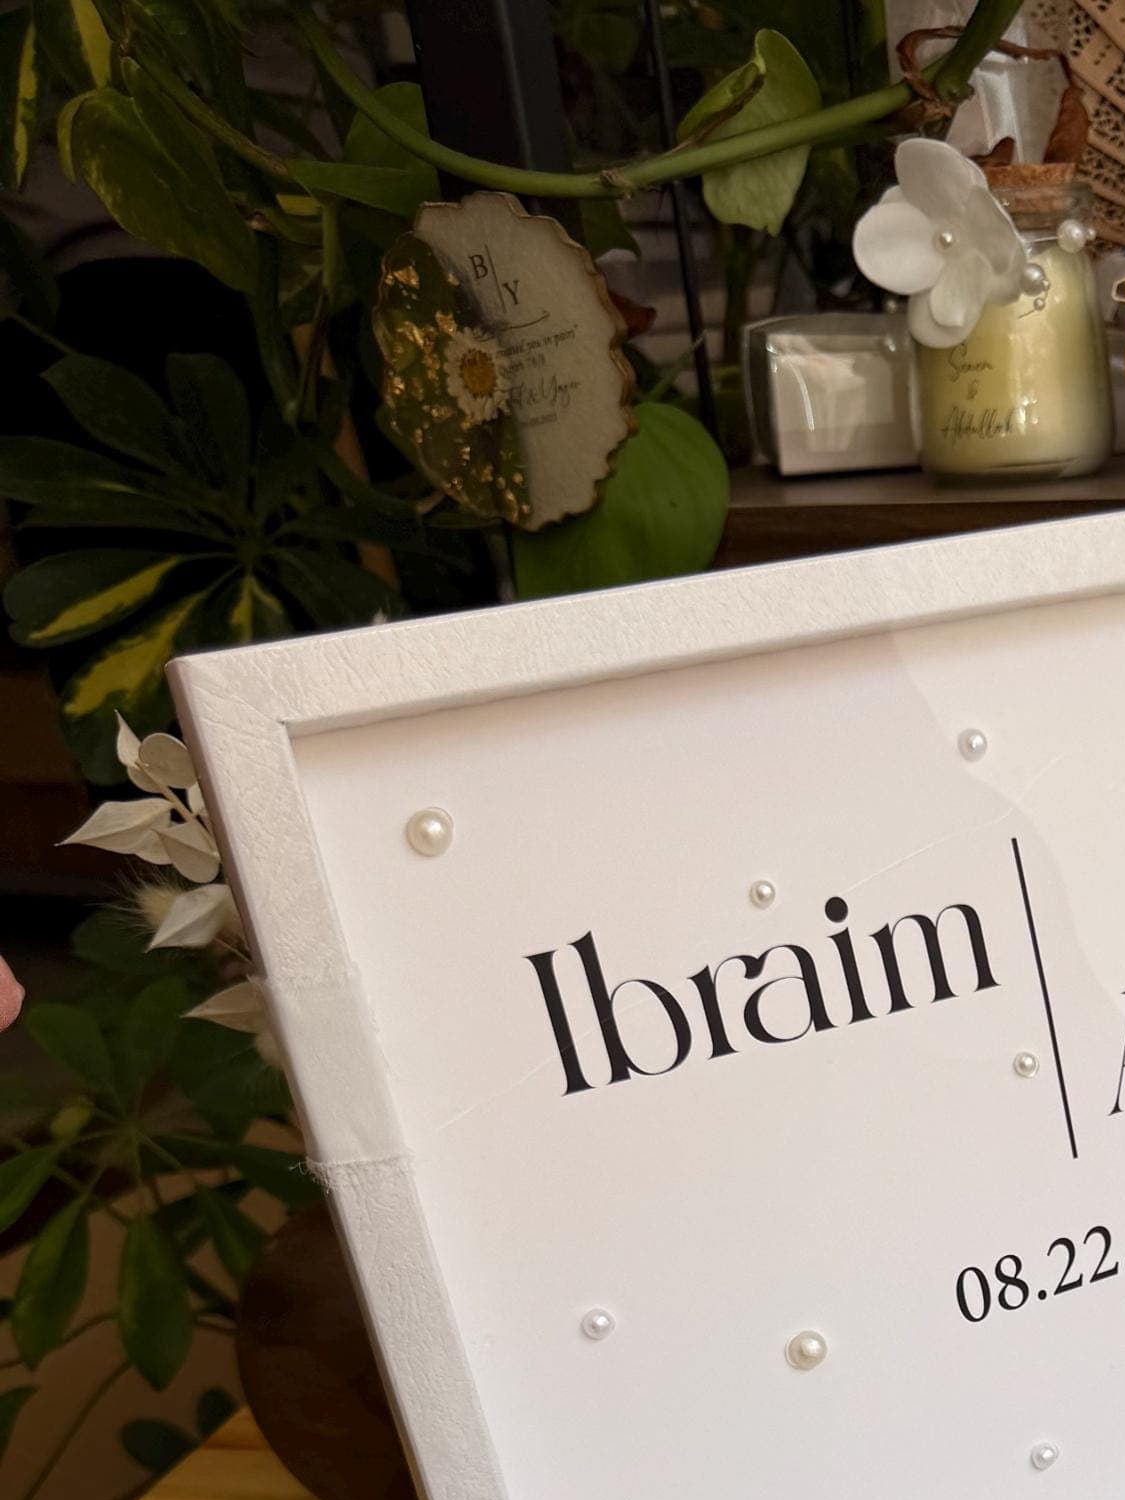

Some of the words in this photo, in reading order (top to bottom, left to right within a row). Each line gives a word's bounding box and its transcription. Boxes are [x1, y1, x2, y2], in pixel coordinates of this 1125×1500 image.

[467, 254, 489, 279] B
[502, 280, 519, 305] Y
[523, 896, 1001, 1096] Ibraim
